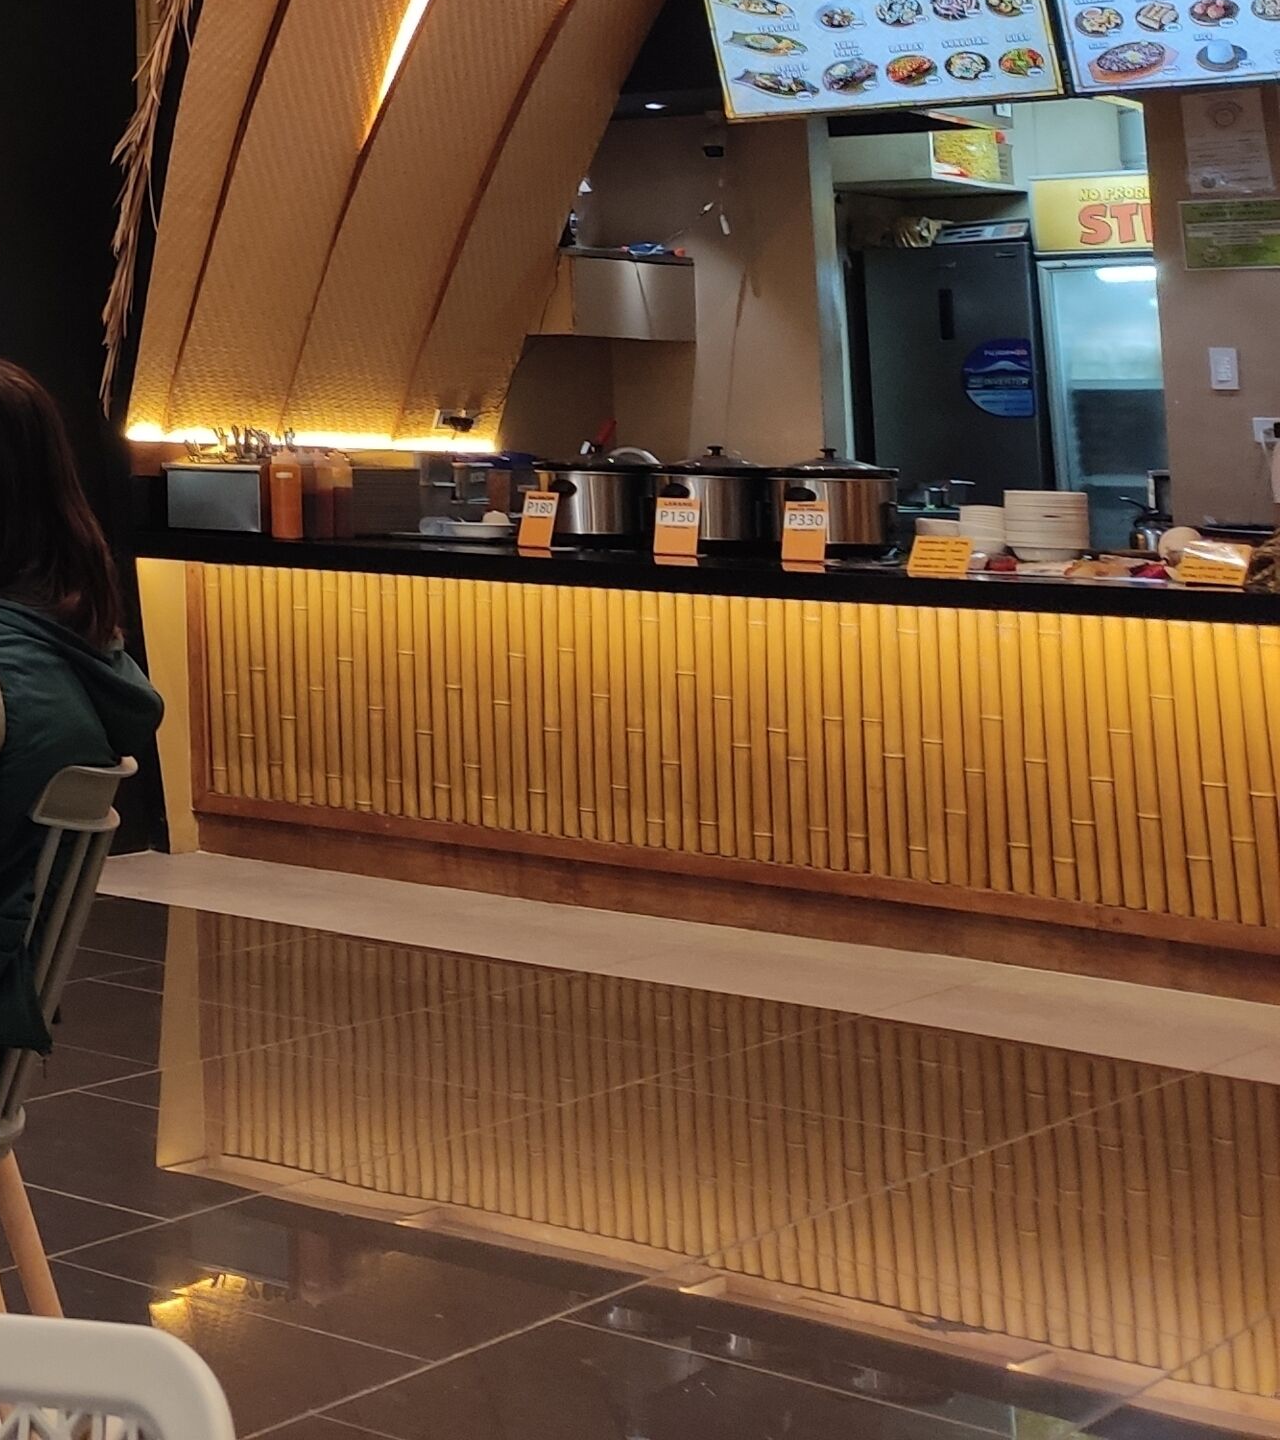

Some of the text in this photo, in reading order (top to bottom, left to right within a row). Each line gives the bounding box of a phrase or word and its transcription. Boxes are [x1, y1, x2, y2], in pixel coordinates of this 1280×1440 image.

[1079, 187, 1100, 202] NO
[526, 501, 554, 515] P180
[659, 509, 696, 524] P150
[788, 512, 825, 527] P330
